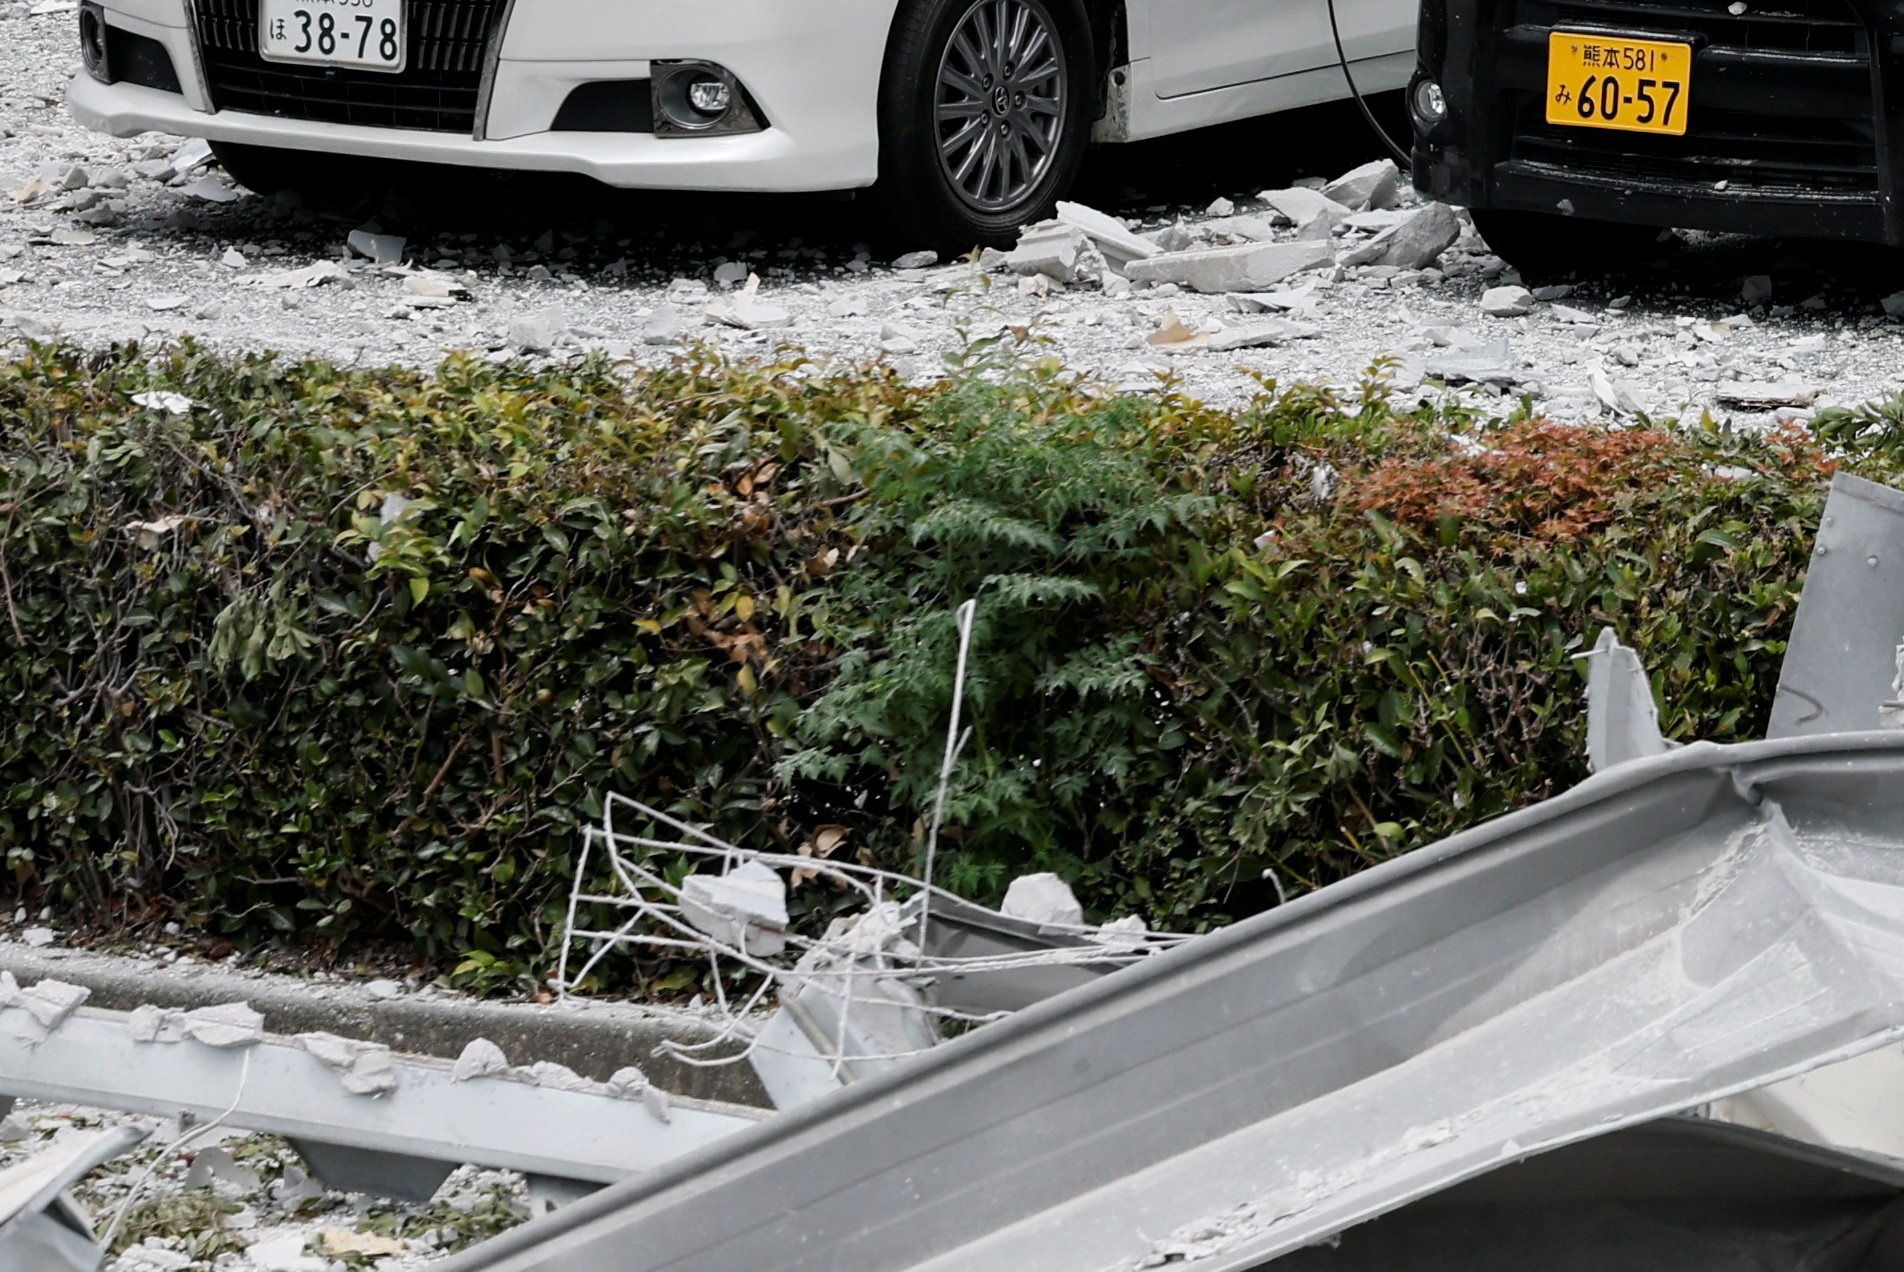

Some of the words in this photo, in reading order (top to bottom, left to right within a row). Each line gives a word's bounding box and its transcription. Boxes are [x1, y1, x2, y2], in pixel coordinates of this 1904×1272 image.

[270, 18, 286, 40] ほ
[294, 10, 397, 61] 38-78
[1555, 84, 1571, 105] み
[1577, 75, 1680, 126] 60-57
